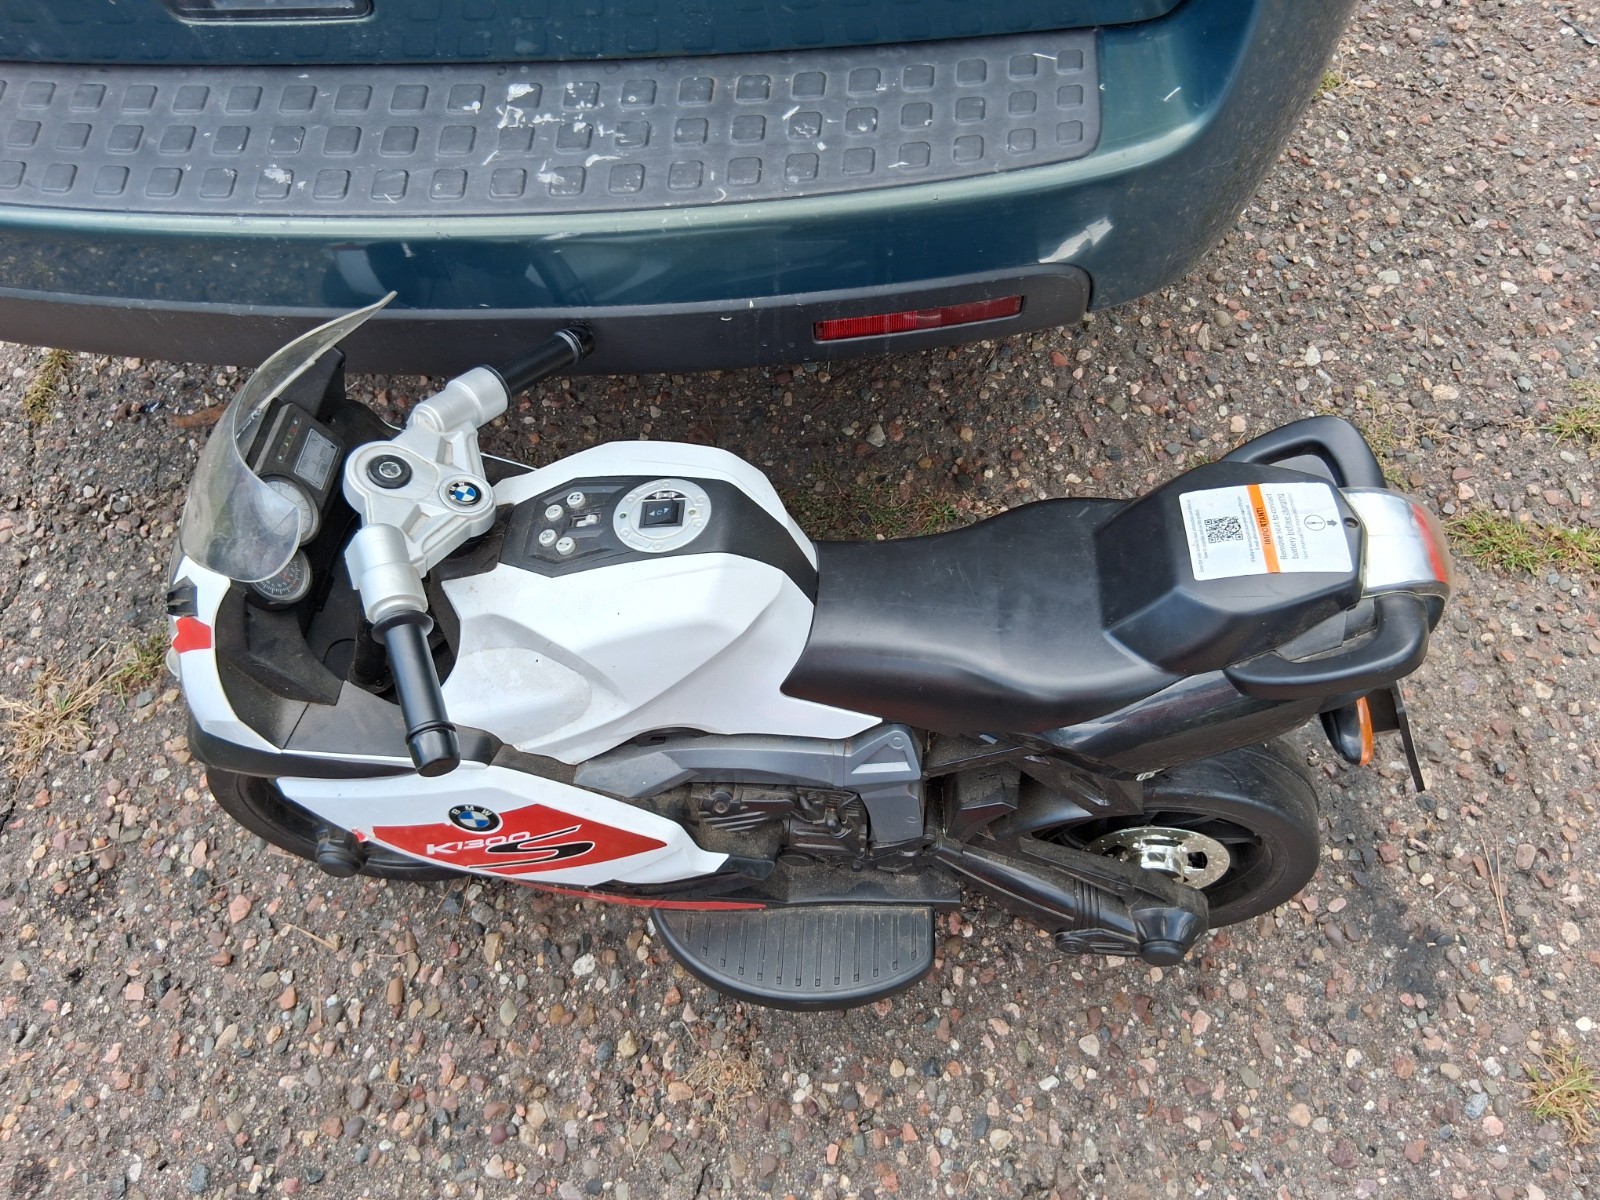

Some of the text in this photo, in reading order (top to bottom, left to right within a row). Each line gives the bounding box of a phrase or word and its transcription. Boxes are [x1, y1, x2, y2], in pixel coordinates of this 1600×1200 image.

[1256, 507, 1271, 545] IMPORTANT!
[1266, 493, 1288, 560] Remove seat to connect
[1277, 493, 1300, 559] battery before charging
[426, 824, 596, 869] K1300 S
